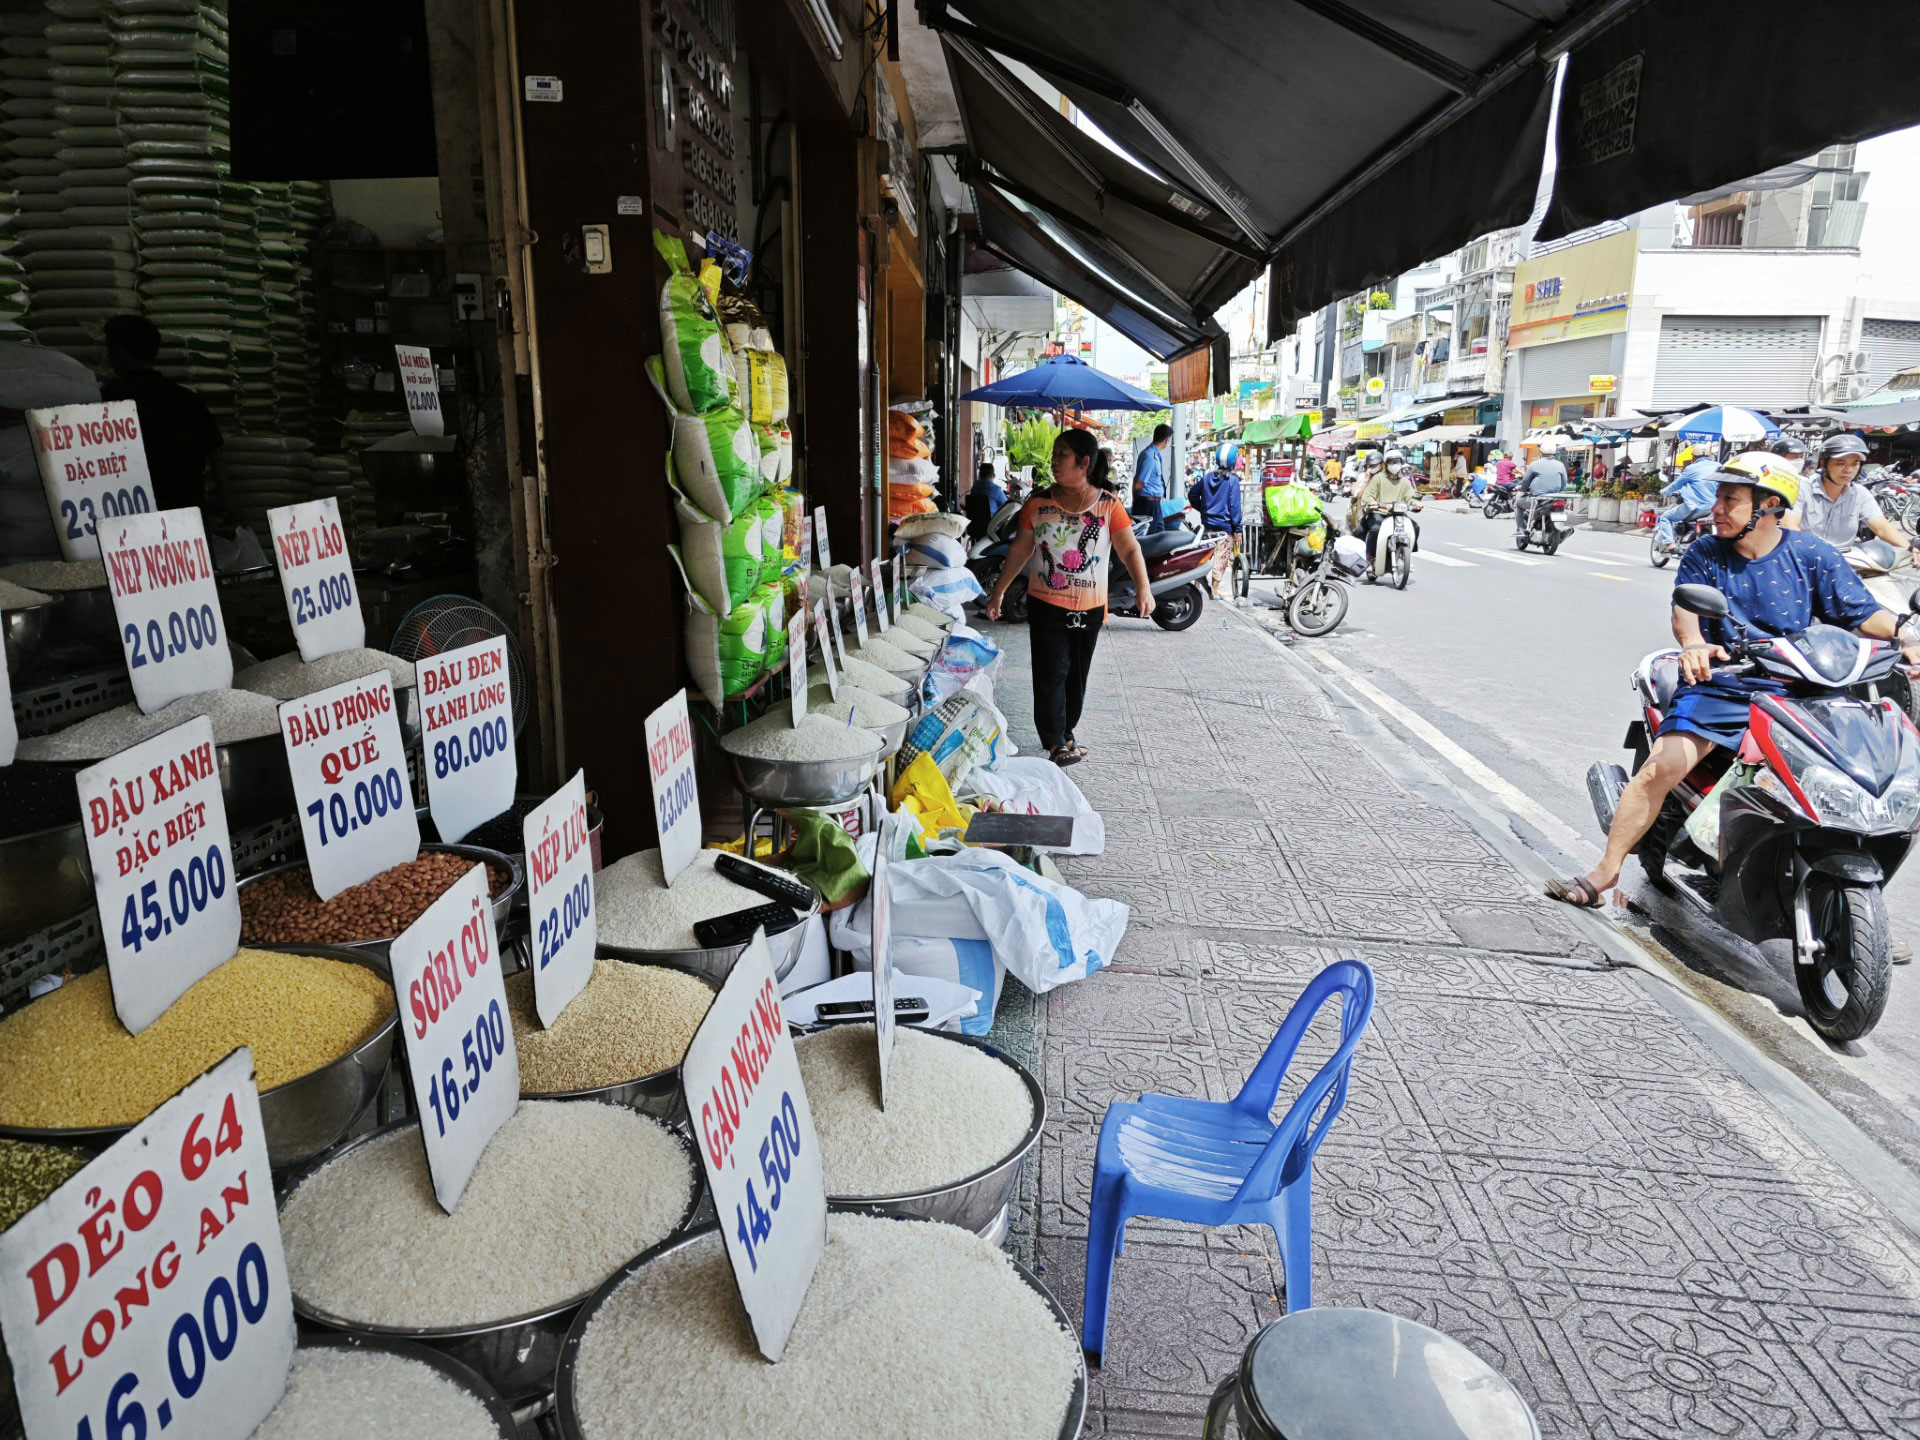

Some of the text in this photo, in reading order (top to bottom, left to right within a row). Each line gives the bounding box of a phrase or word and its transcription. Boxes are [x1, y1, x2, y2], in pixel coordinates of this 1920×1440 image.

[688, 83, 736, 161] 8632269
[690, 140, 738, 205] 8655483
[1536, 277, 1562, 301] SHB
[35, 413, 74, 453] NẾP
[64, 451, 128, 485] ĐẶC BIỆT
[107, 528, 143, 598] NẾP
[276, 515, 344, 571] NẾP LÀO
[291, 572, 353, 626] 25.000
[124, 603, 217, 670] 20.000
[424, 648, 502, 696] ĐẬU ĐEN
[287, 684, 391, 749] ĐẬU PHỘNG
[425, 681, 506, 732] XANH LÒNG
[321, 724, 380, 785] QUẾ
[433, 715, 508, 780] 80.000
[650, 709, 691, 783] NẾP THÁI
[88, 741, 214, 838] ĐẬU XANH
[306, 767, 403, 847] 70.000
[659, 766, 694, 834] 23.000
[116, 800, 206, 878] ĐẶC BIỆT
[530, 799, 587, 895] NẾP LỨC
[121, 844, 226, 954] 45.000
[539, 873, 590, 972] 22.000
[408, 894, 489, 1040] SƠRI CŨ
[428, 998, 505, 1139] 16.500
[701, 976, 782, 1171] GẠO NGANG
[26, 1091, 244, 1327] DẺO 64
[737, 1090, 801, 1274] 14.500
[48, 1170, 250, 1397] LONG AN
[77, 1241, 269, 1440] 6.000
